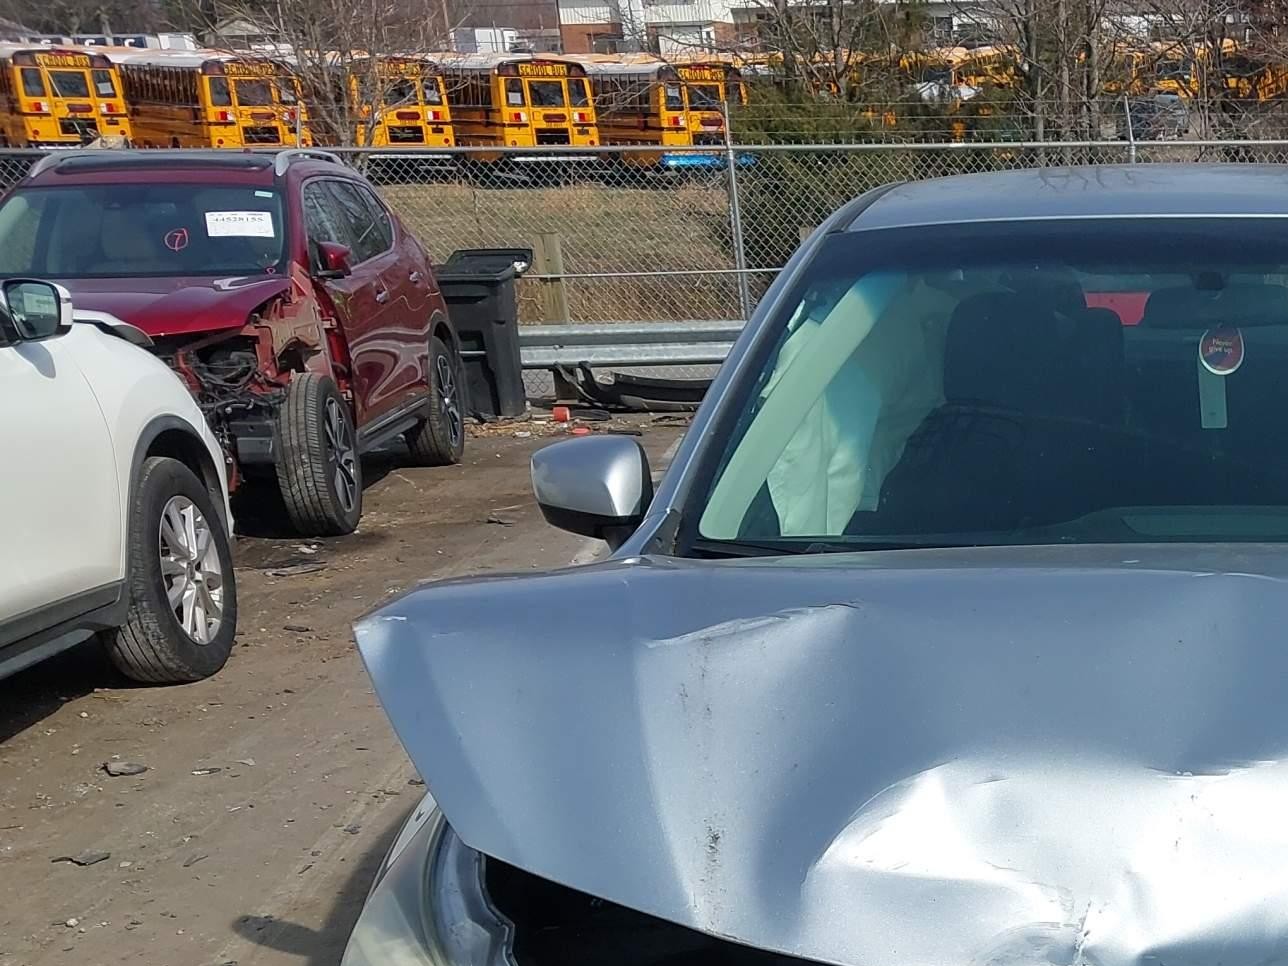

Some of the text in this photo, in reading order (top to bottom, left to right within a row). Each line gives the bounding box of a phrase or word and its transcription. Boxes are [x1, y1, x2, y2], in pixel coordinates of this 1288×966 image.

[73, 55, 89, 67] BUS
[520, 65, 566, 76] SCHOOL BUS
[679, 69, 708, 80] SCHOOL
